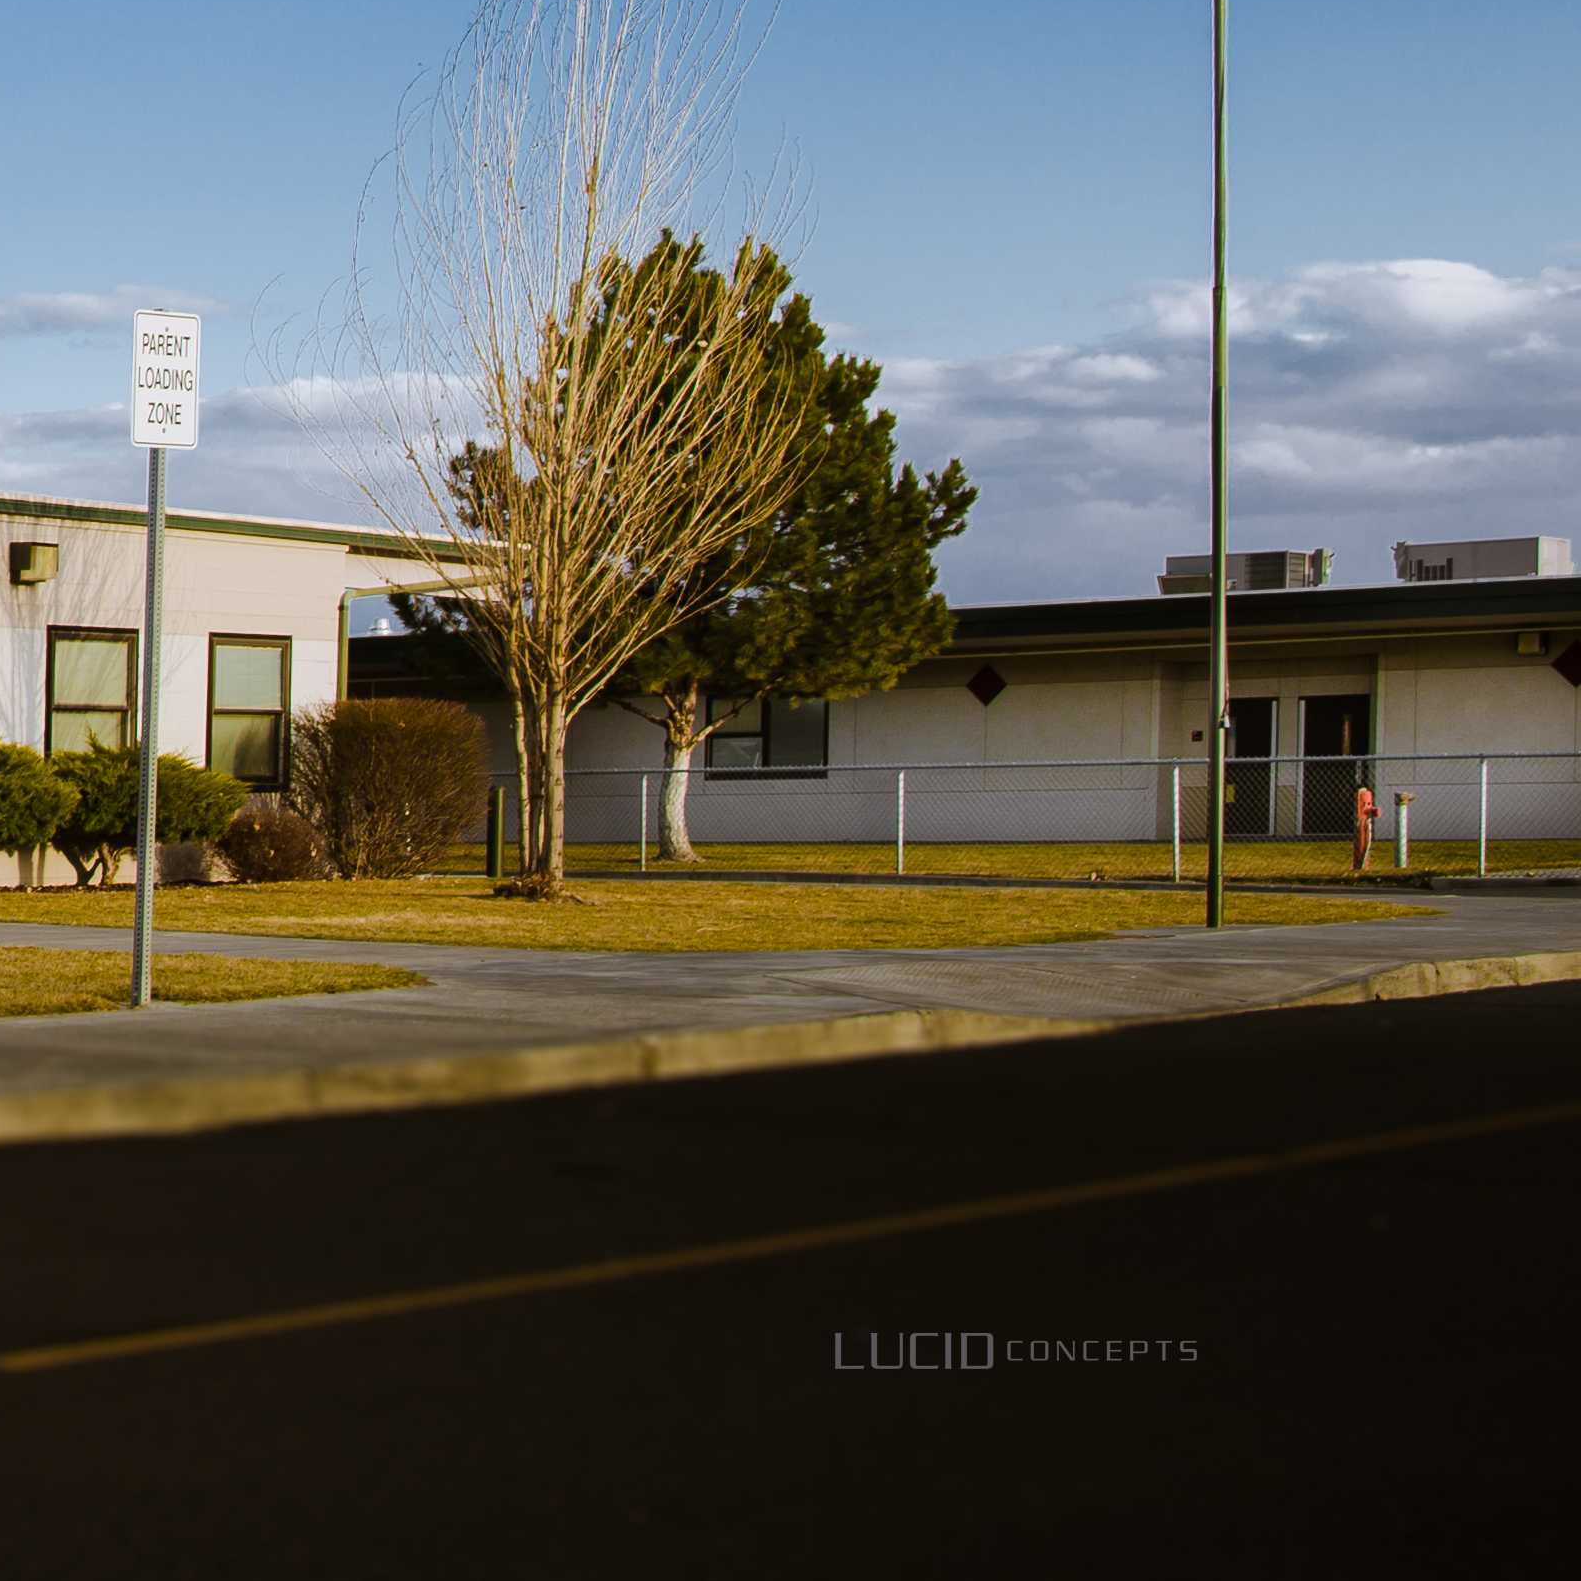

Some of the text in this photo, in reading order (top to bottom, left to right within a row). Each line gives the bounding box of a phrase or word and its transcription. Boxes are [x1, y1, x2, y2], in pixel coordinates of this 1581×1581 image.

[141, 333, 191, 358] PARENT
[138, 366, 193, 392] LOADING
[147, 402, 182, 425] ZONE
